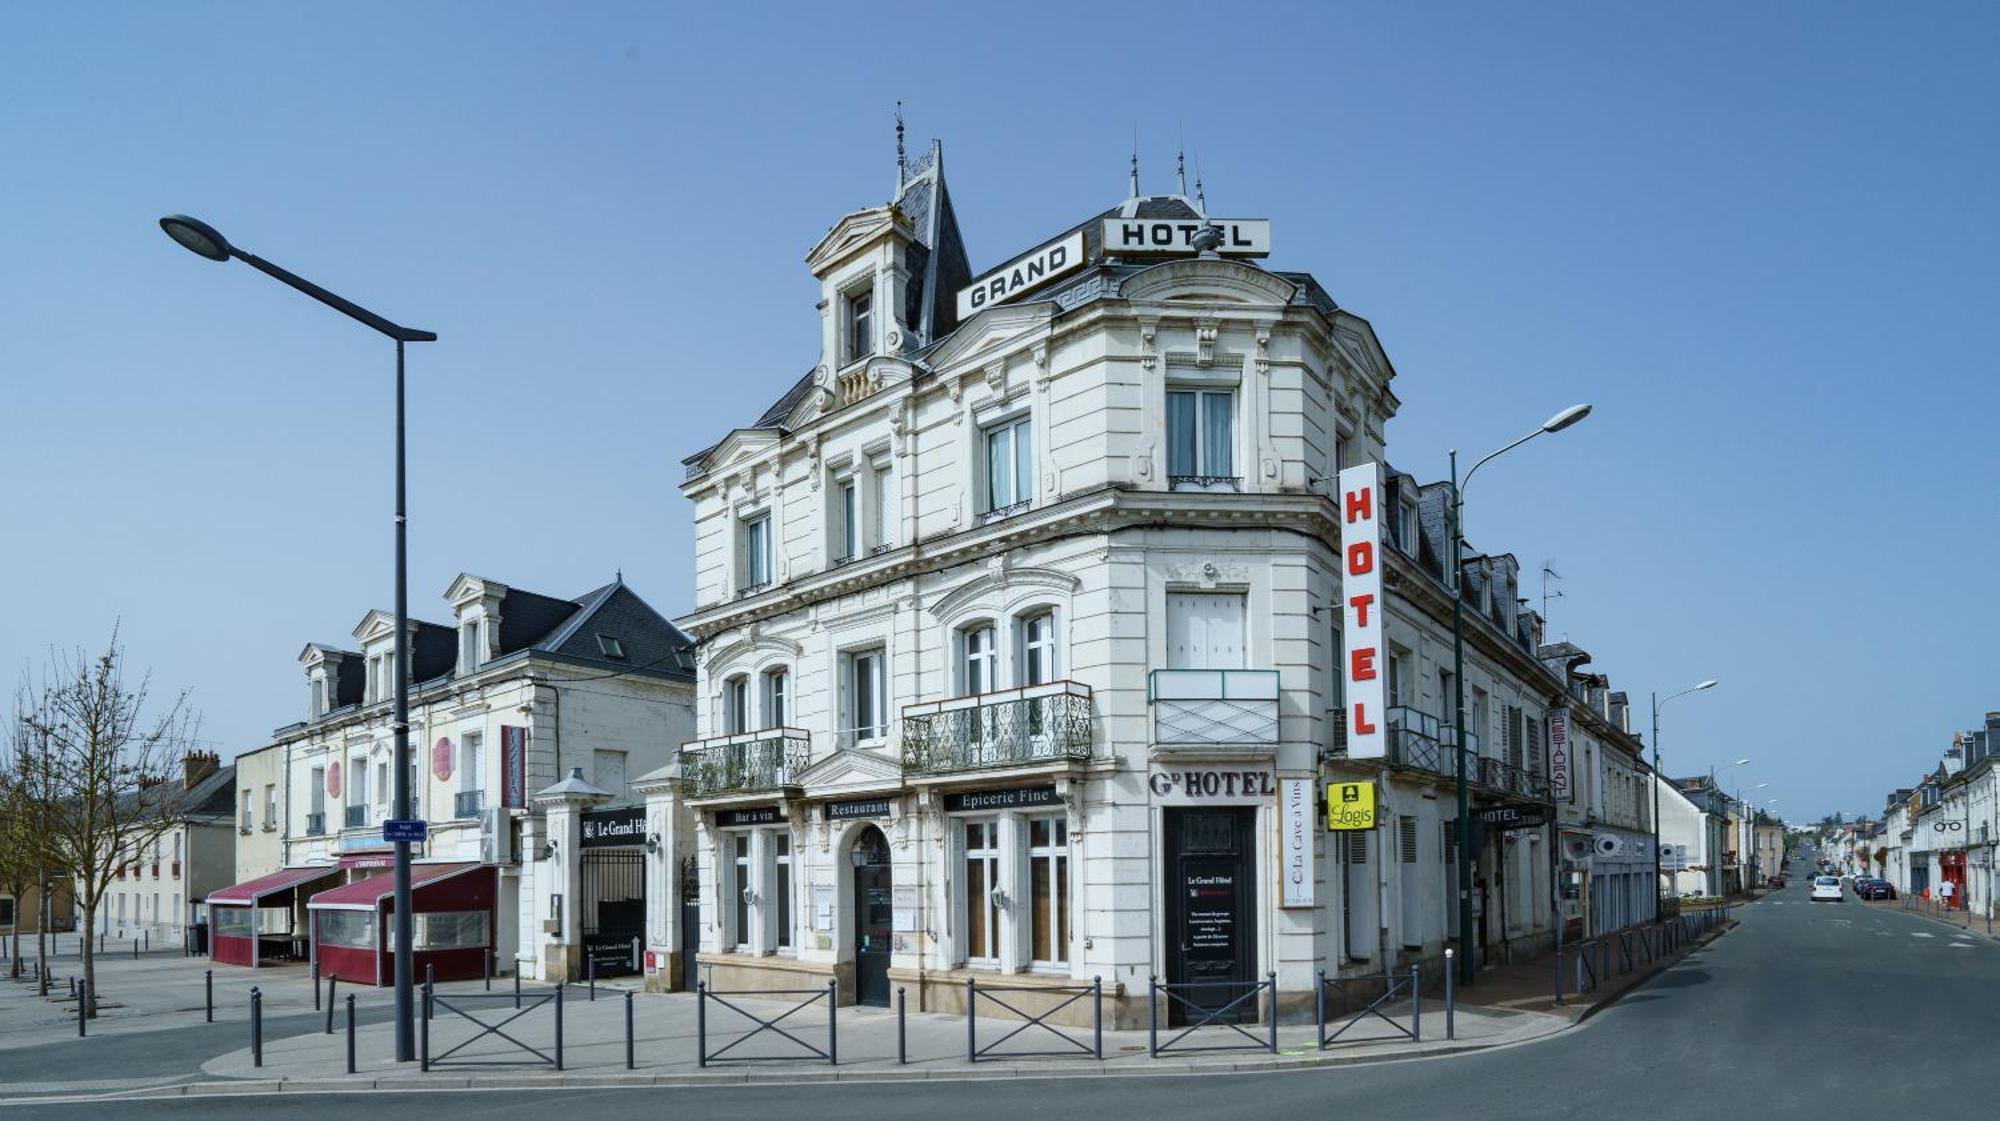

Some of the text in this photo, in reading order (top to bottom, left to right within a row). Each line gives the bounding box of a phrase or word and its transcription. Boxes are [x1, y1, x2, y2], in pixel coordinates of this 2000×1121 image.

[970, 245, 1068, 309] GRAND
[1346, 487, 1377, 736] HOTEL
[1551, 717, 1567, 796] RESTAURANT
[1185, 771, 1275, 797] HOTEL
[1291, 781, 1302, 809] Vins
[831, 802, 889, 816] Restaurant
[962, 789, 1049, 808] Epicerie Fine
[735, 812, 749, 822] Bar
[759, 809, 773, 821] vin
[1329, 803, 1372, 827] Logis
[1480, 808, 1519, 823] HOTEL
[597, 822, 608, 837] Le
[608, 819, 633, 836] Grand
[1292, 820, 1303, 850] Cave
[1292, 855, 1303, 868] La
